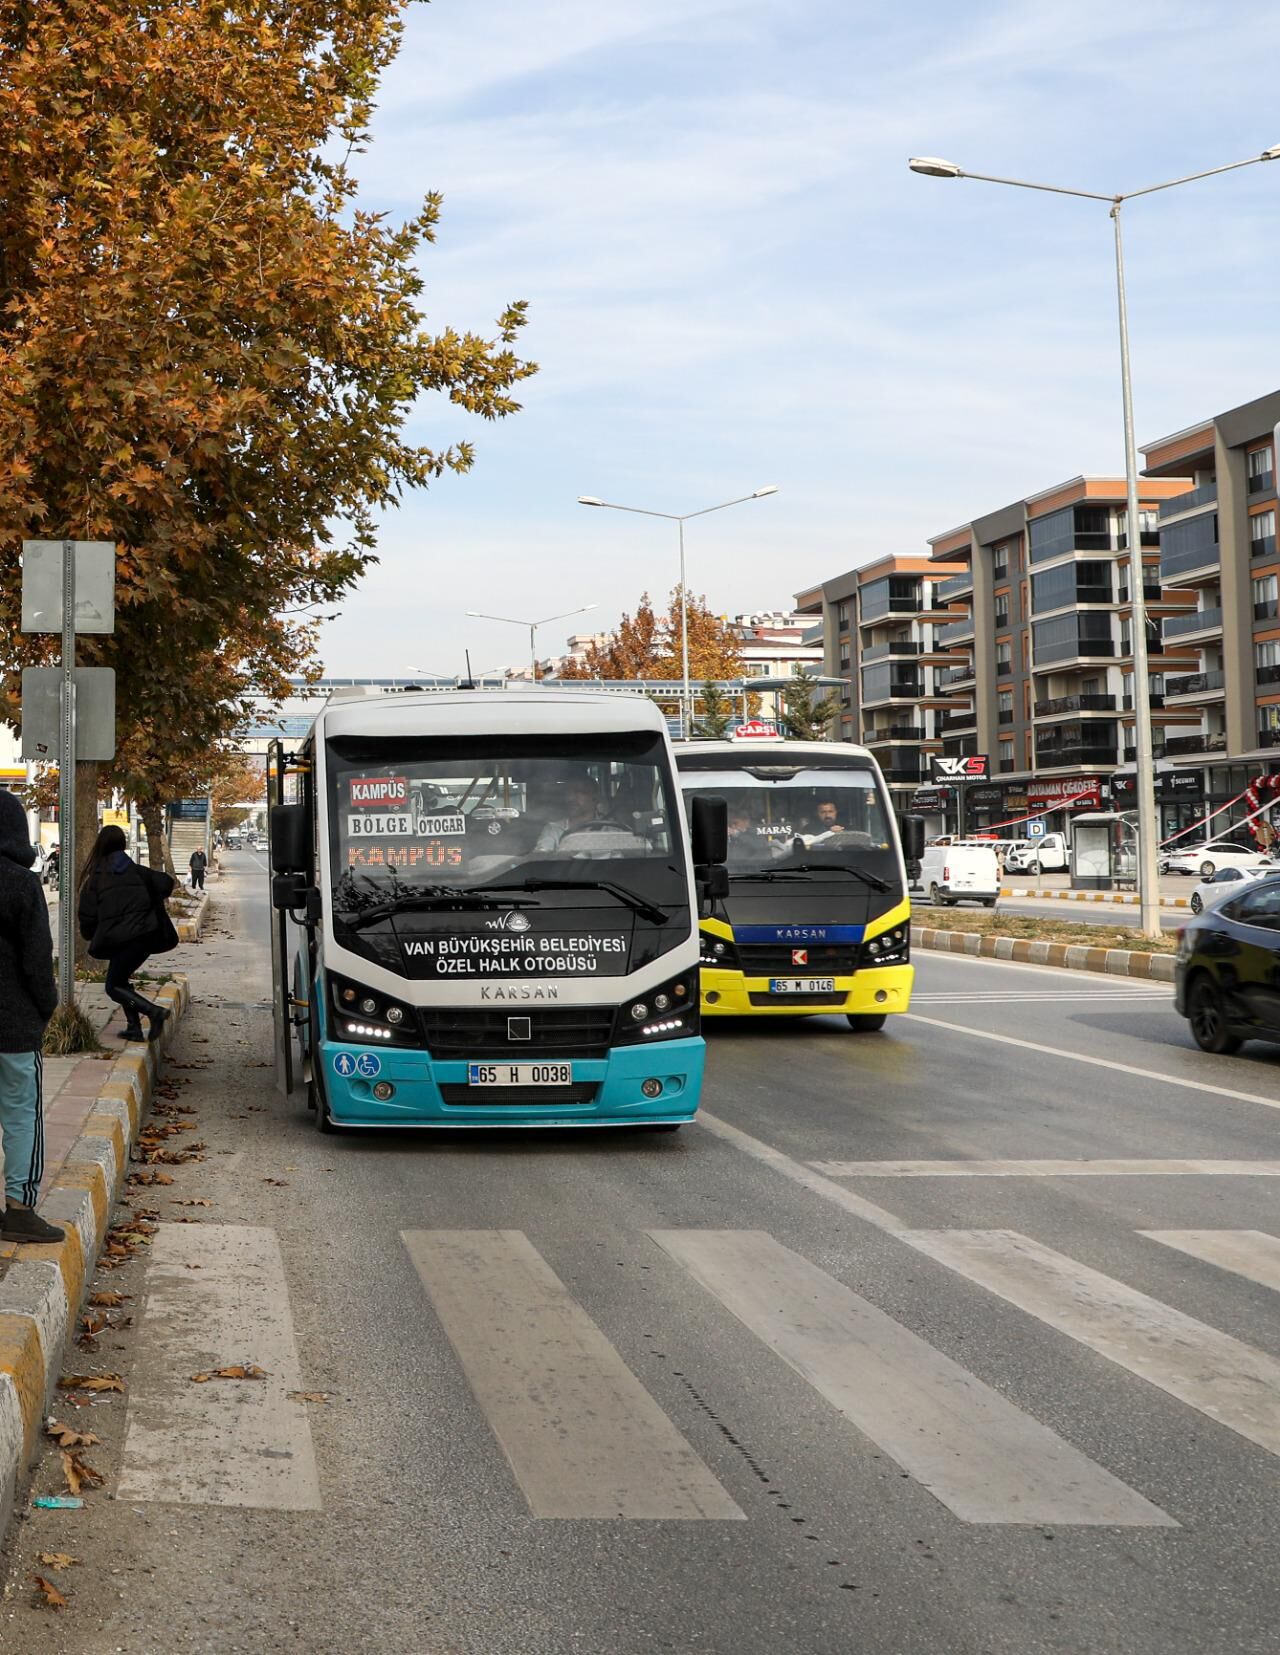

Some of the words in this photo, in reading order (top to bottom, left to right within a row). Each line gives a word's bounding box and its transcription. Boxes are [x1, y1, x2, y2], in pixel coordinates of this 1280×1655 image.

[737, 725, 775, 737] ÇARŞI
[934, 757, 986, 775] RKS
[352, 779, 405, 800] KAMPÜS
[1028, 783, 1062, 797] ADIYAMAN
[352, 815, 407, 834] BÖLGE
[419, 817, 464, 834] OTOGAR
[756, 825, 793, 836] MARAŞ
[1032, 824, 1041, 835] D
[348, 840, 462, 866] KAMPÜS
[776, 929, 826, 939] KARSAN
[404, 941, 434, 956] VAN
[438, 936, 535, 956] BÜYÜKŞEHİR
[540, 935, 626, 952] BELEDİYESİ
[436, 957, 476, 974] ÖZEL
[479, 956, 520, 972] HALK
[524, 954, 597, 972] OTOBÜSÜ
[481, 985, 558, 1000] KARSAN
[776, 981, 788, 991] 65
[795, 981, 802, 991] M
[809, 981, 832, 991] 0146
[479, 1066, 497, 1083] 65
[510, 1066, 519, 1083] H
[532, 1066, 568, 1082] 0038
